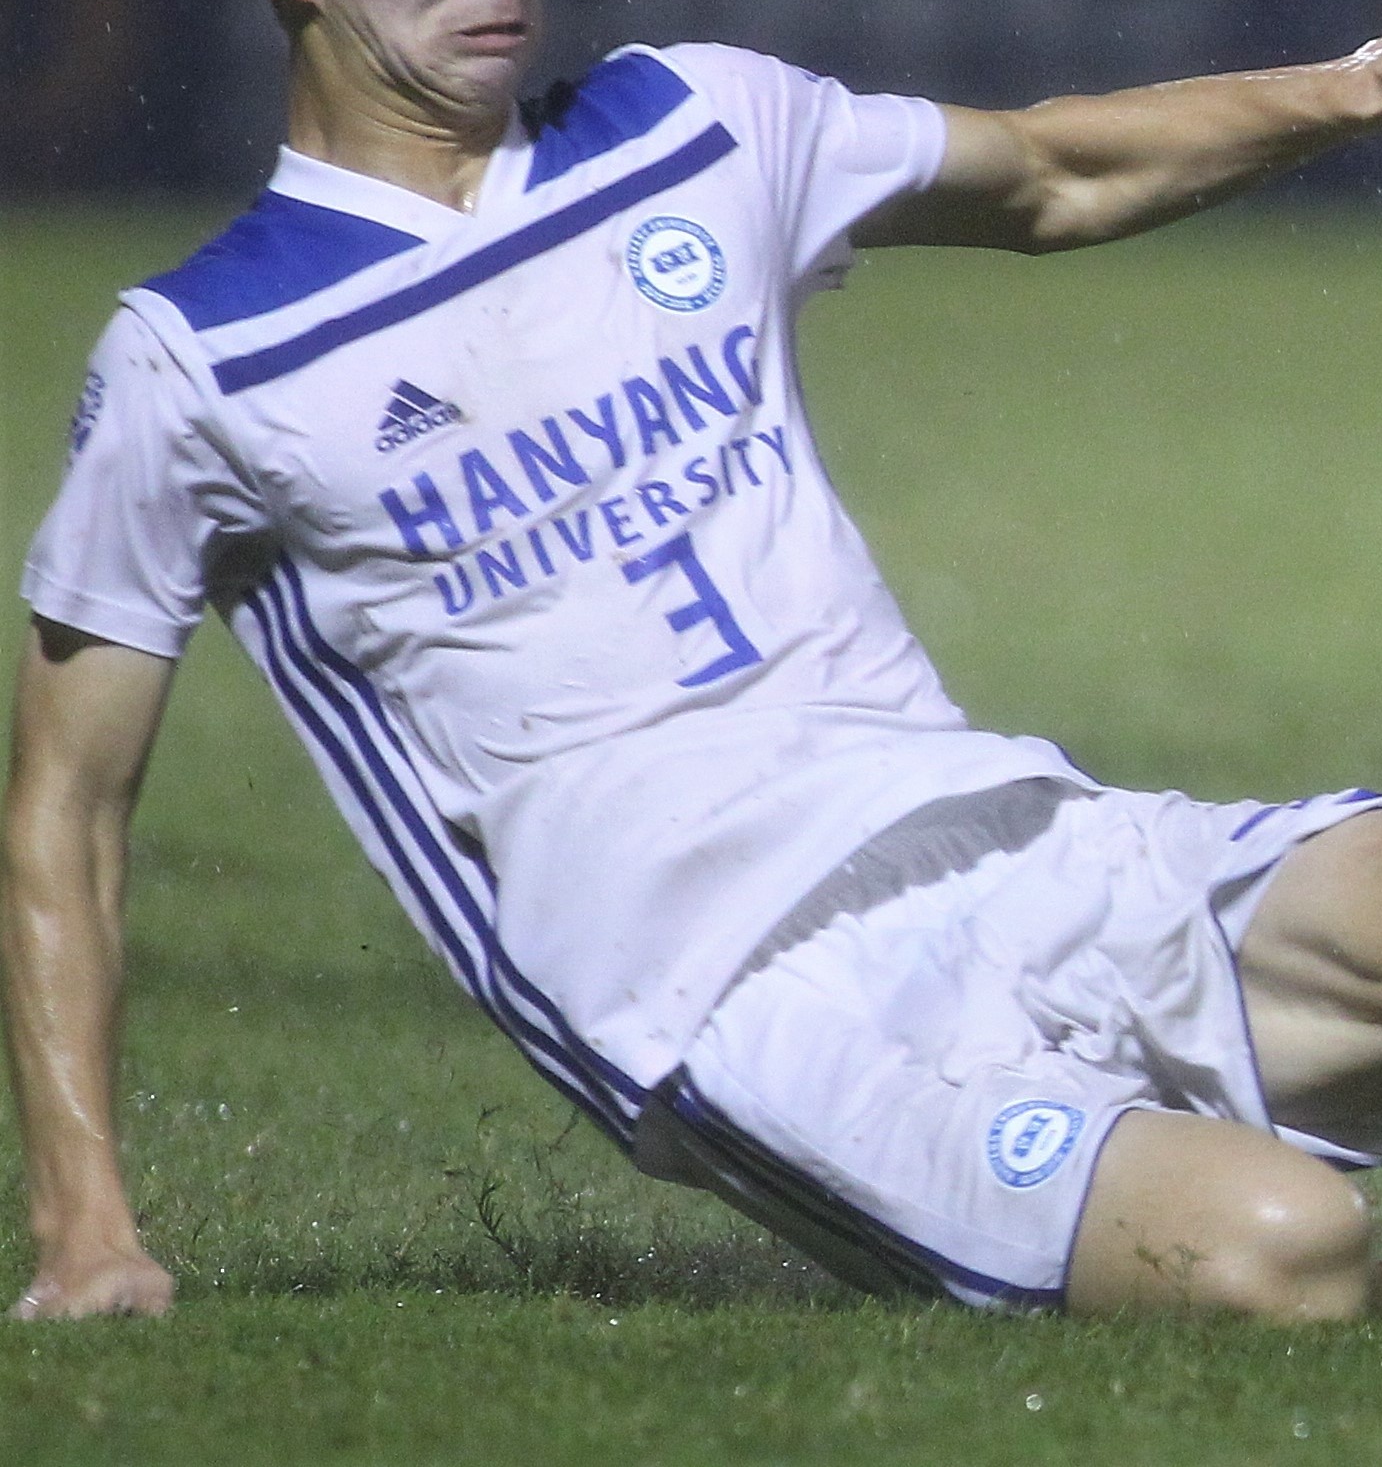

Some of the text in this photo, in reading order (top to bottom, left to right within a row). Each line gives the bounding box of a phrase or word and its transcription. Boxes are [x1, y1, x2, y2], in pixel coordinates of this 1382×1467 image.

[378, 325, 763, 557] HANYANG
[433, 426, 793, 615] UNIVERSITY
[622, 532, 763, 687] 3
